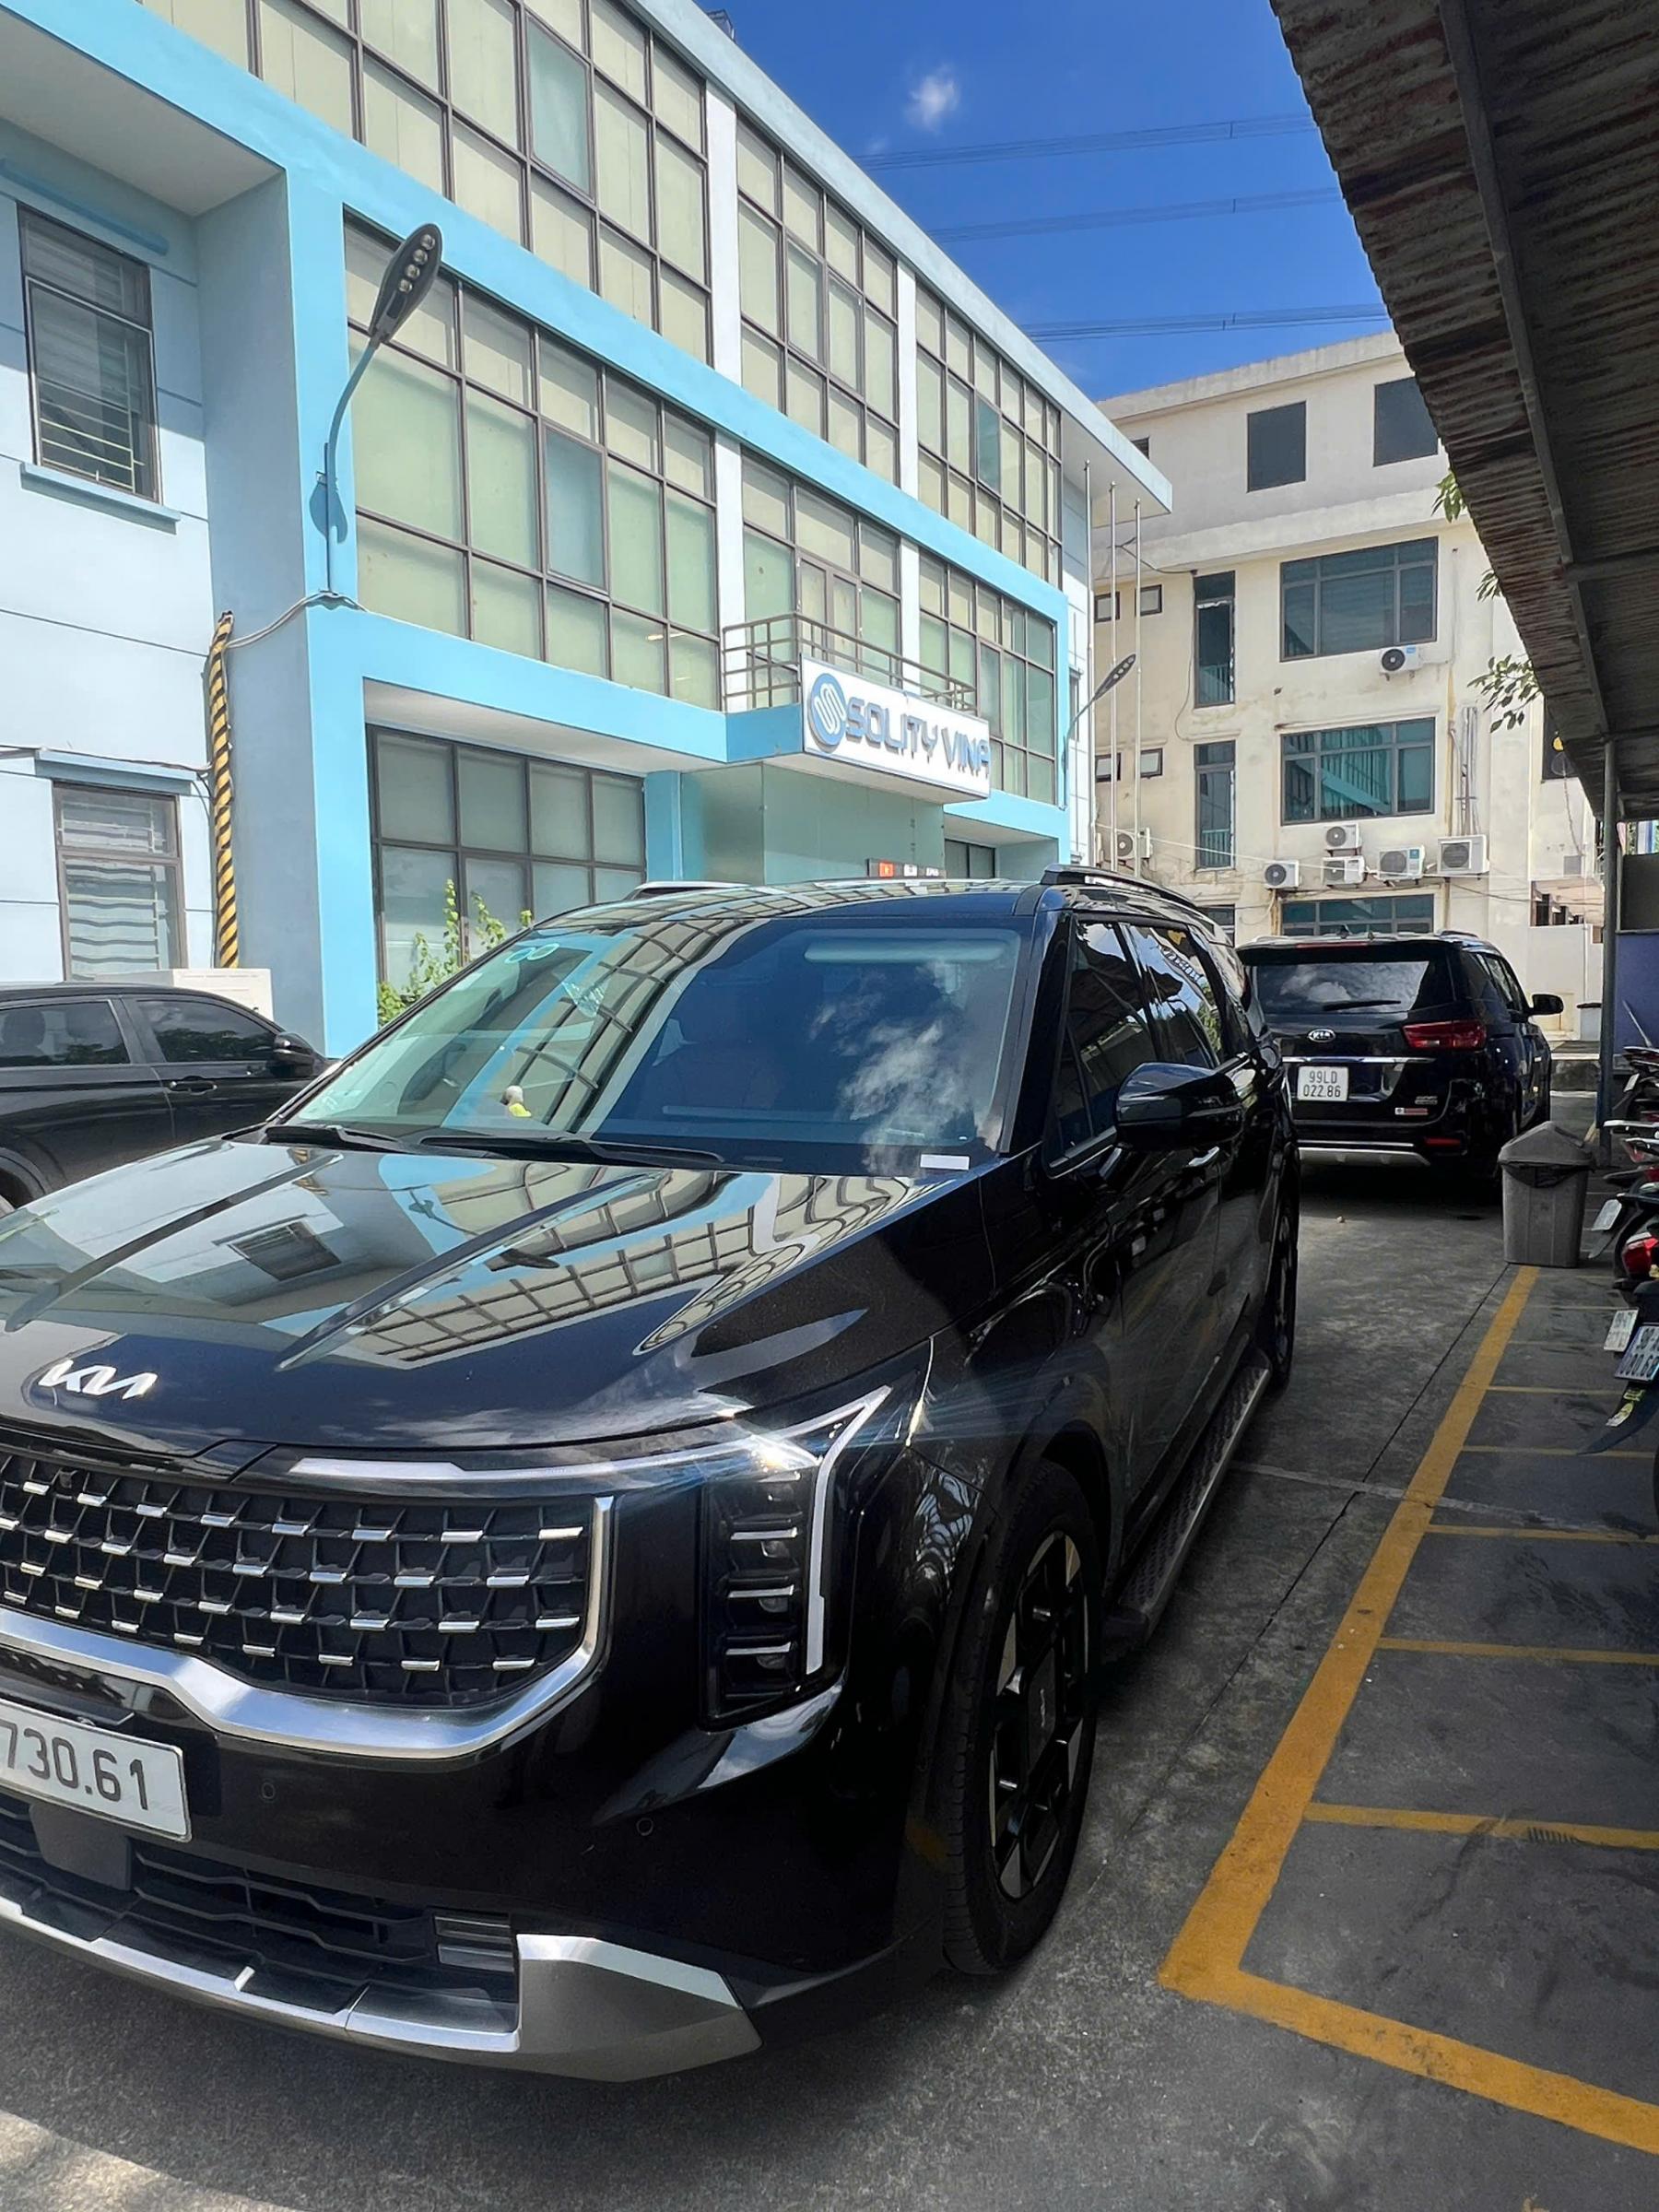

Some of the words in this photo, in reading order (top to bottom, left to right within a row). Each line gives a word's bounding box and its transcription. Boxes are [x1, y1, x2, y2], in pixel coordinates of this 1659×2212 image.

[846, 697, 938, 761] SOLITY
[940, 726, 991, 778] VINA
[1302, 1084, 1341, 1098] 022.86
[1309, 1070, 1338, 1084] 99LD
[0, 1717, 148, 1811] 730.61
